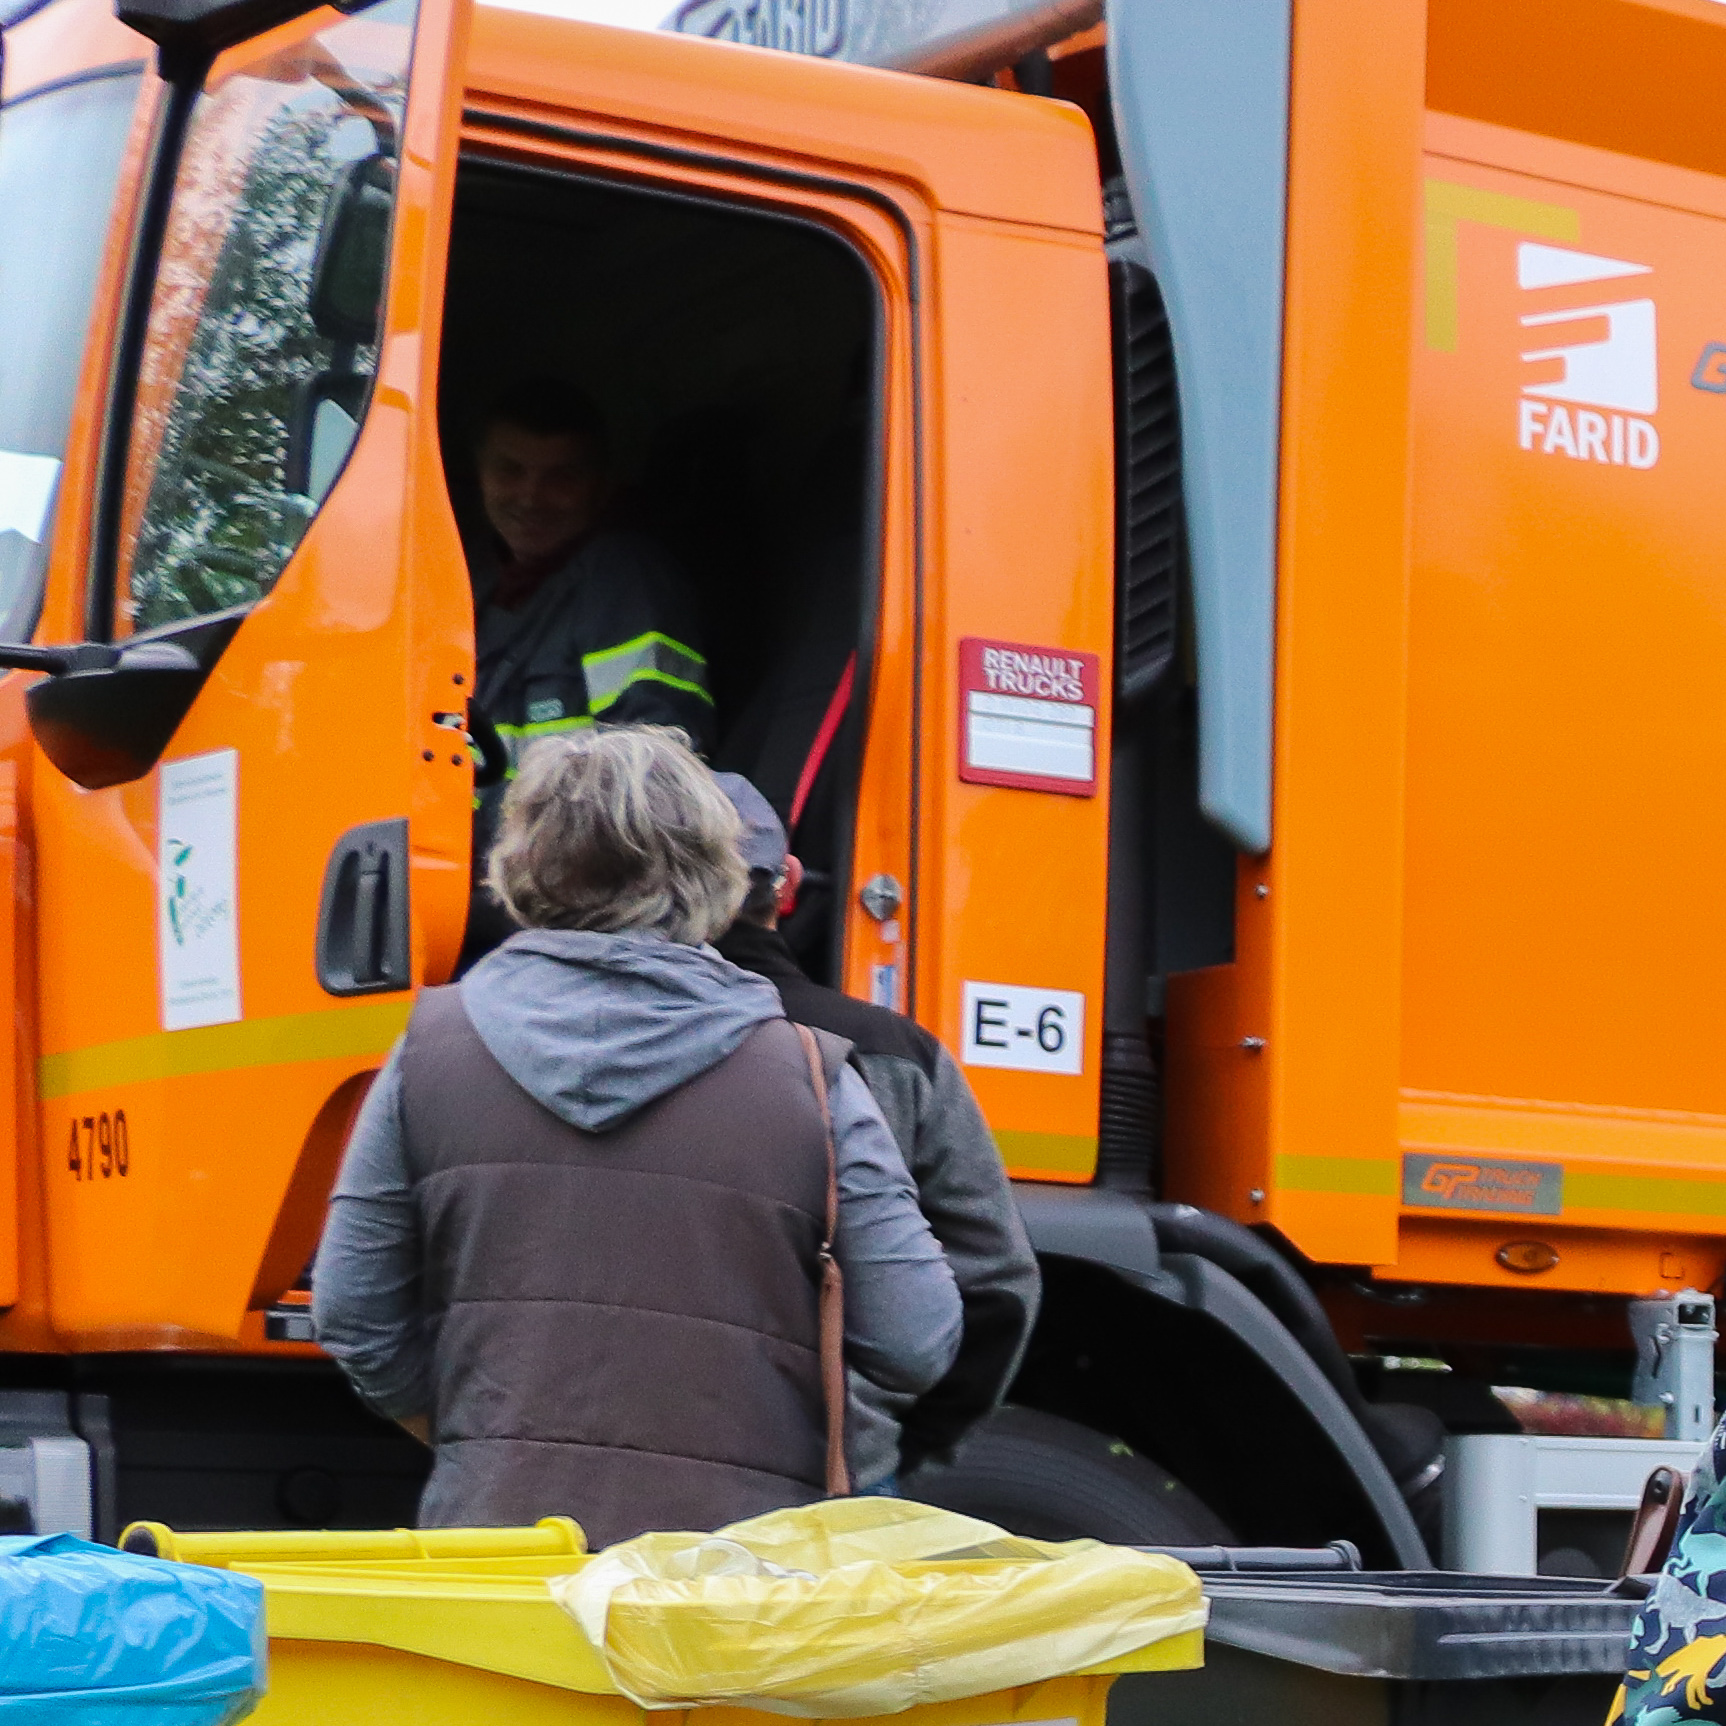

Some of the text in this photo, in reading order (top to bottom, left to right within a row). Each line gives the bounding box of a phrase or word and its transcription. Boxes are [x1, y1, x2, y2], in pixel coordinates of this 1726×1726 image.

[1518, 400, 1660, 470] FARID
[983, 647, 1085, 680] RENAULT
[984, 667, 1085, 701] TRUCKS
[972, 1000, 1067, 1055] E-6
[66, 1109, 130, 1182] 4790
